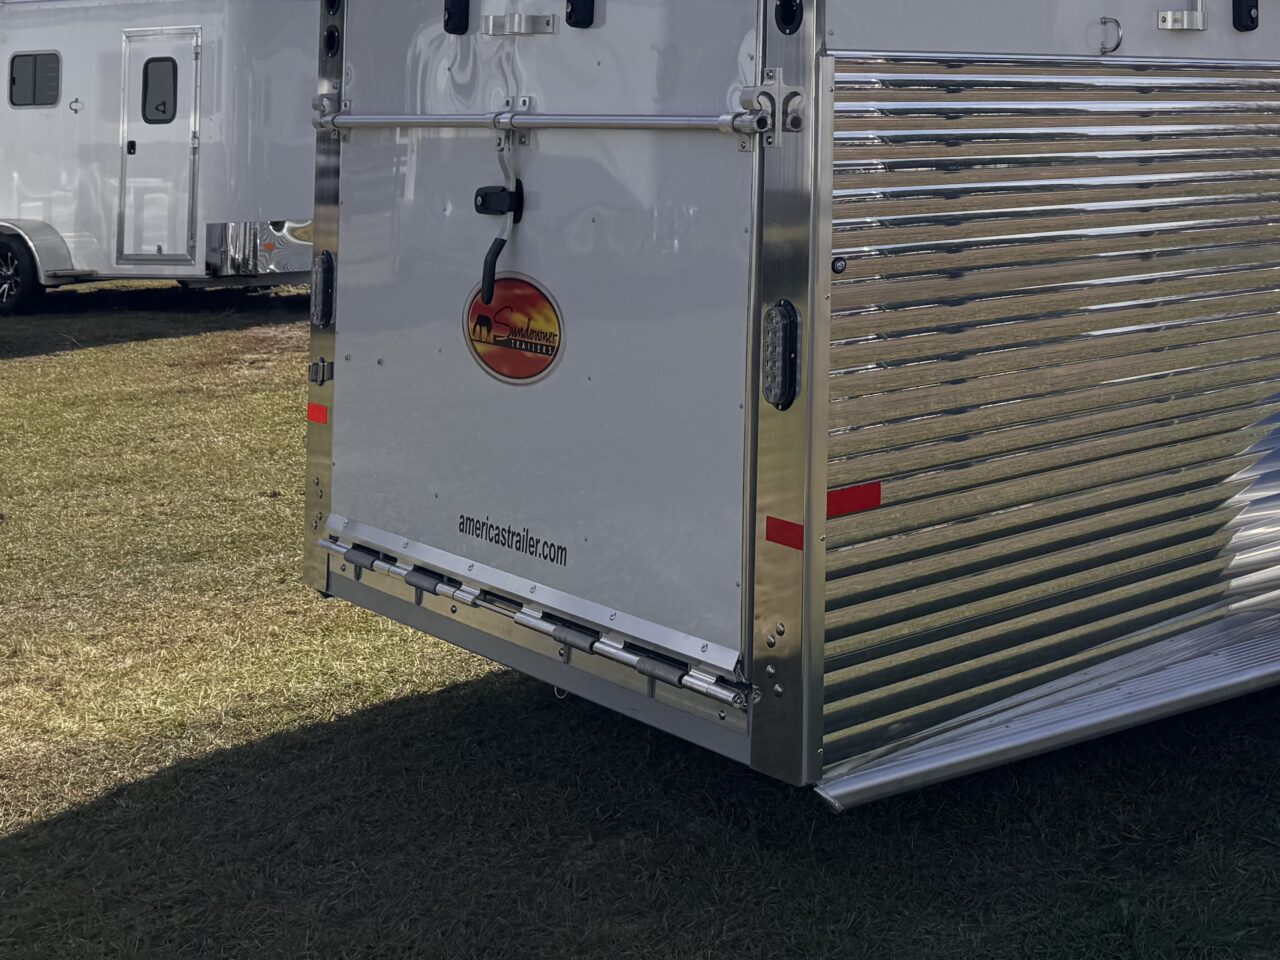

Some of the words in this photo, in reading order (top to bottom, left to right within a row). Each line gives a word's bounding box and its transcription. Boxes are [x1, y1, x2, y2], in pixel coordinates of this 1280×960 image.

[494, 306, 557, 344] Sundowner
[511, 339, 552, 354] TRAILERS
[458, 514, 567, 566] americastrailer.com
